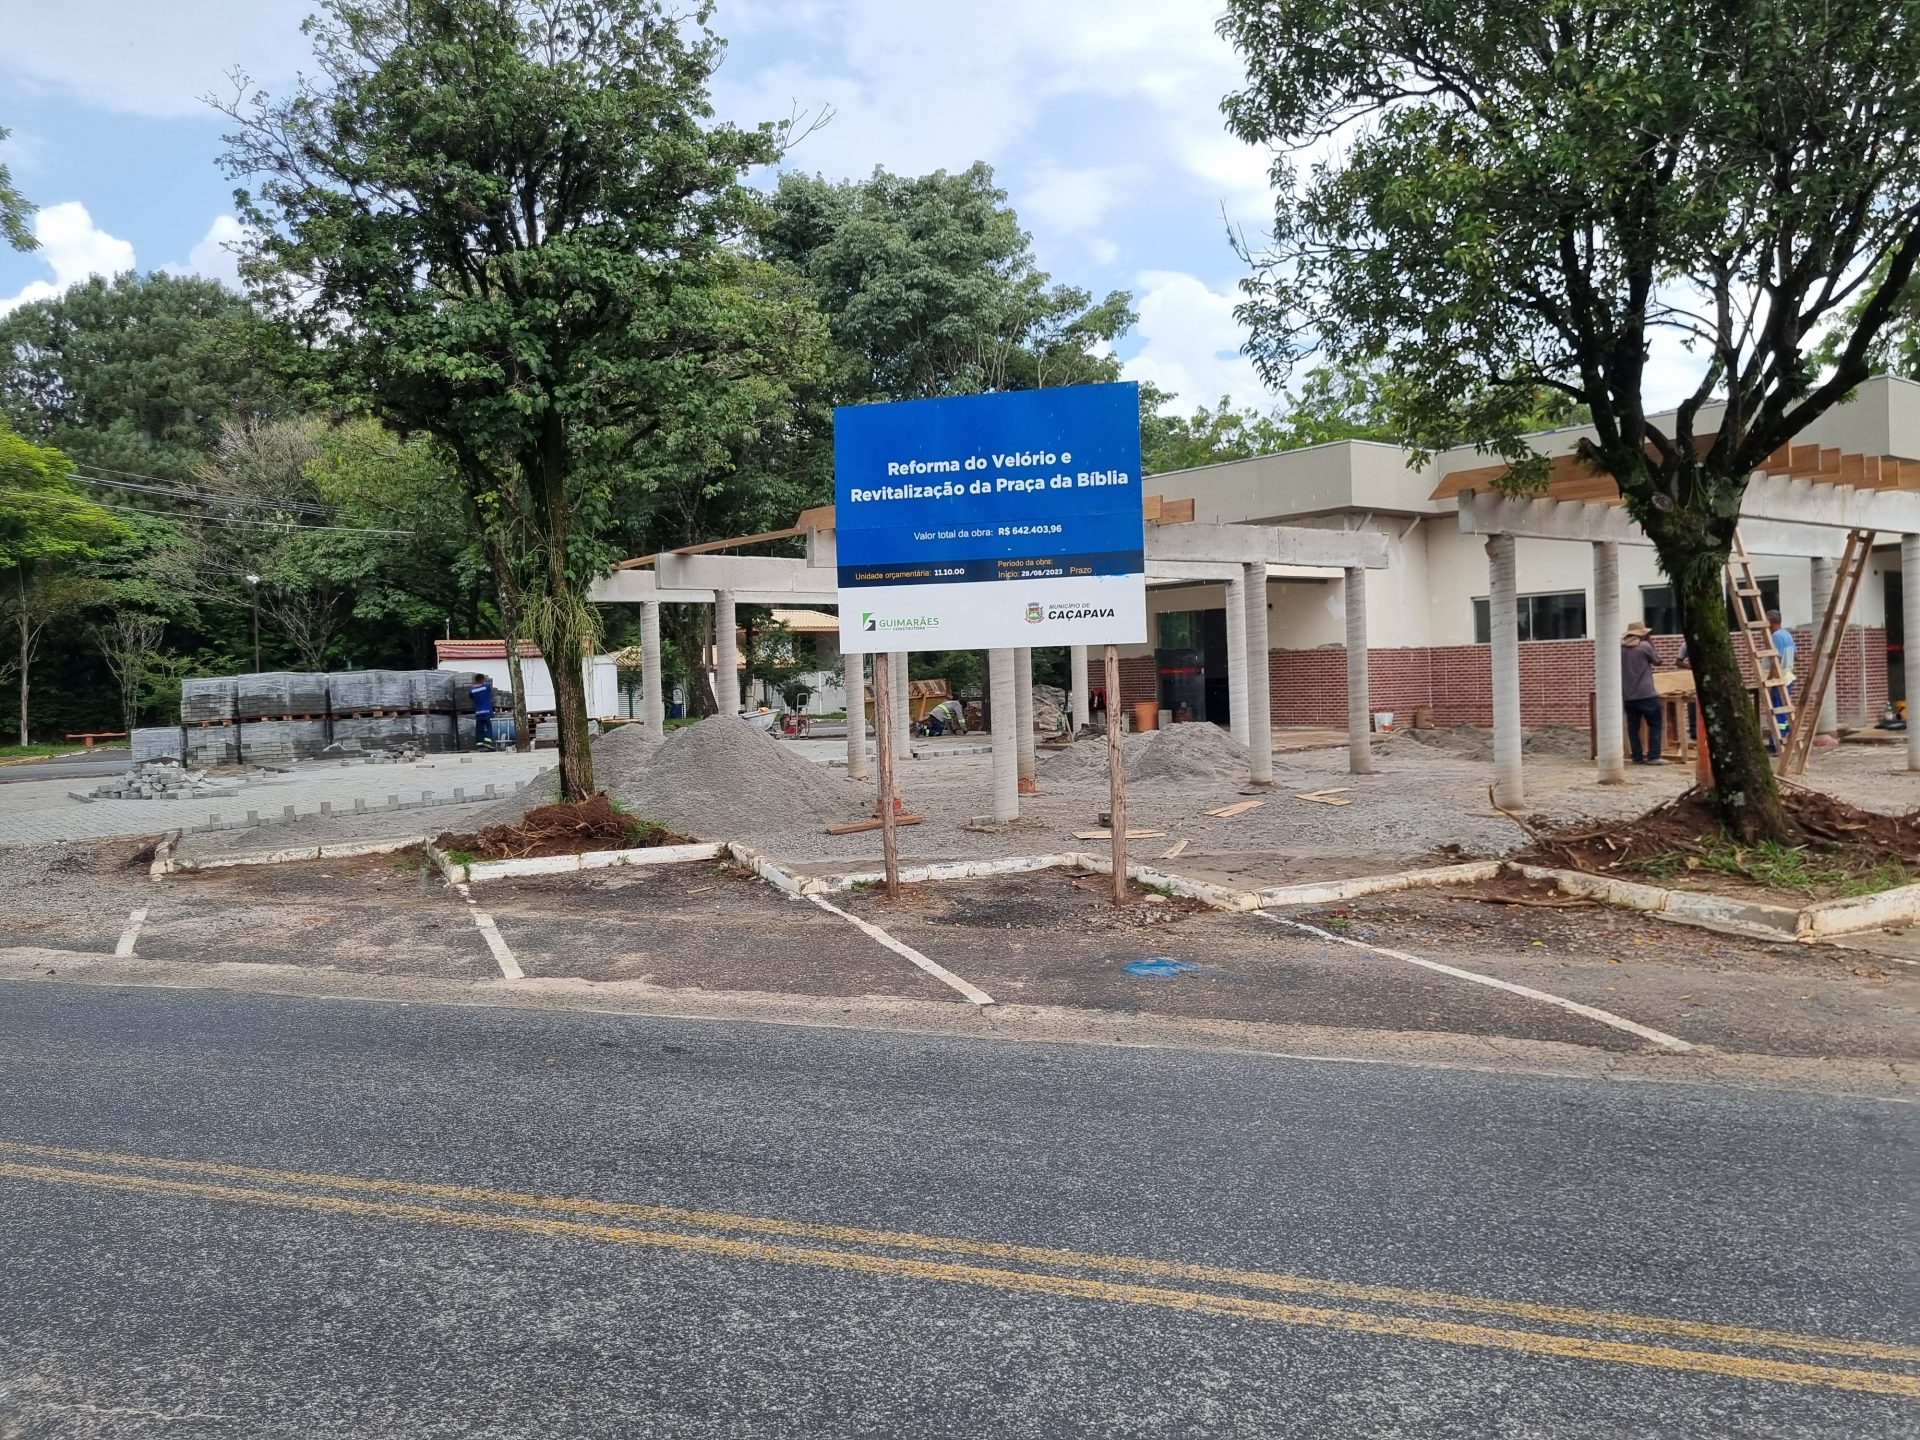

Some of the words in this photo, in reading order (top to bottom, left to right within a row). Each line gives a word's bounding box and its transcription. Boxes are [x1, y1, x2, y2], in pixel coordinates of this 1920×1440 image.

[888, 459, 960, 476] Reforma
[965, 456, 988, 471] do
[992, 451, 1057, 468] Velório
[1061, 453, 1072, 465] e
[851, 479, 965, 503] Revitalização
[969, 480, 992, 494] da
[996, 476, 1046, 494] Praça
[1050, 475, 1073, 489] da
[1077, 470, 1129, 488] Bíblia
[914, 531, 936, 541] Valor
[938, 530, 956, 539] total
[958, 529, 970, 538] da
[971, 528, 994, 537] obra:
[998, 527, 1010, 536] R$
[1012, 524, 1062, 535] 642.403,96
[1025, 558, 1034, 566] da
[1035, 558, 1053, 567] obra:
[885, 570, 931, 579] orçamentária:
[1069, 566, 1092, 574] Prazo
[1048, 608, 1115, 622] CAÇAPAVA
[879, 616, 939, 627] GUIMARÃES
